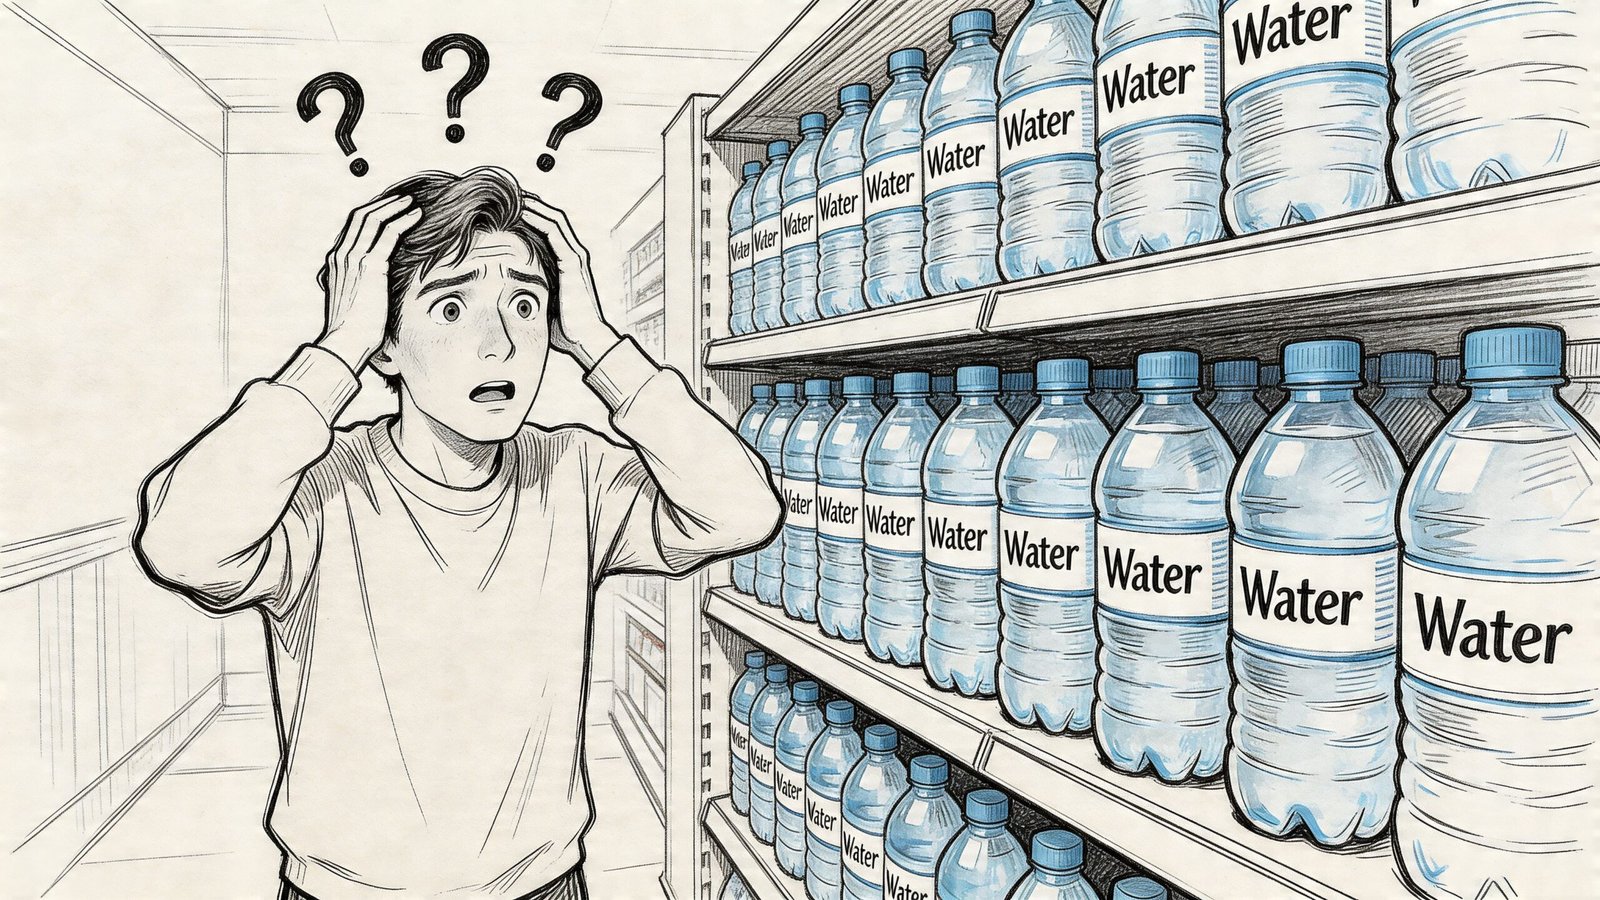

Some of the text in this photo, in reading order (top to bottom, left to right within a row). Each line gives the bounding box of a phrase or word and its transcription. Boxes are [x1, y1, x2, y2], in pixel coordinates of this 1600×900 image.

[1231, 1, 1353, 66] Water
[422, 33, 490, 144] ?
[1101, 61, 1197, 114] Water
[296, 71, 370, 178] ?
[536, 72, 603, 173] ?
[1003, 107, 1075, 151] Water
[926, 142, 986, 179] Water
[818, 192, 859, 222] Water
[866, 170, 915, 203] Water
[818, 495, 859, 525] Water
[865, 504, 916, 537] Water
[927, 516, 989, 552] Water
[1003, 529, 1080, 571] Water
[1103, 545, 1203, 595] Water
[1239, 565, 1364, 626] Water
[1414, 592, 1573, 665] Water
[843, 830, 880, 869] Water
